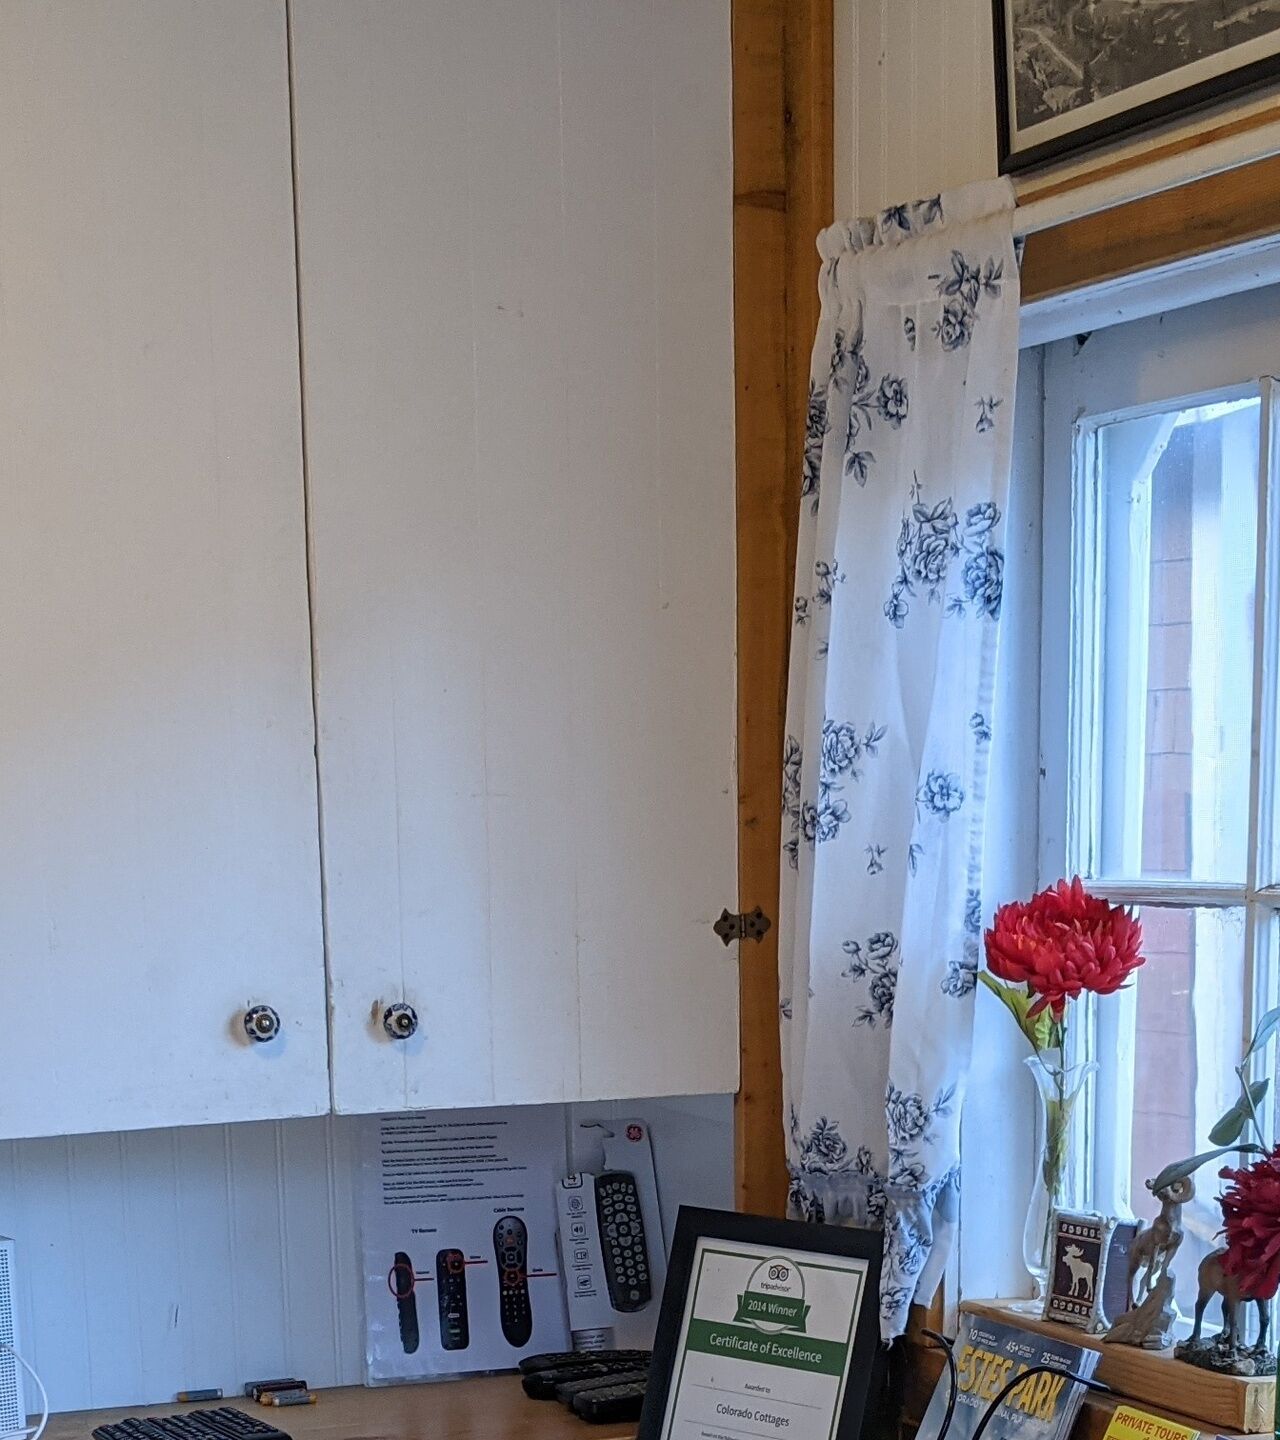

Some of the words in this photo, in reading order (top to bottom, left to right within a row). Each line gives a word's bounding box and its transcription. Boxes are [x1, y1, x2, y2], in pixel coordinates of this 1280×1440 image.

[760, 1282, 791, 1294] tripadvisor
[747, 1299, 767, 1312] 2014
[767, 1301, 798, 1318] Winner
[709, 1332, 758, 1353] Certificate
[759, 1342, 771, 1355] of
[771, 1343, 822, 1364] Excellence
[716, 1403, 753, 1420] Colorado
[754, 1411, 790, 1428] Cottages
[1115, 1412, 1154, 1437] PRIVATE
